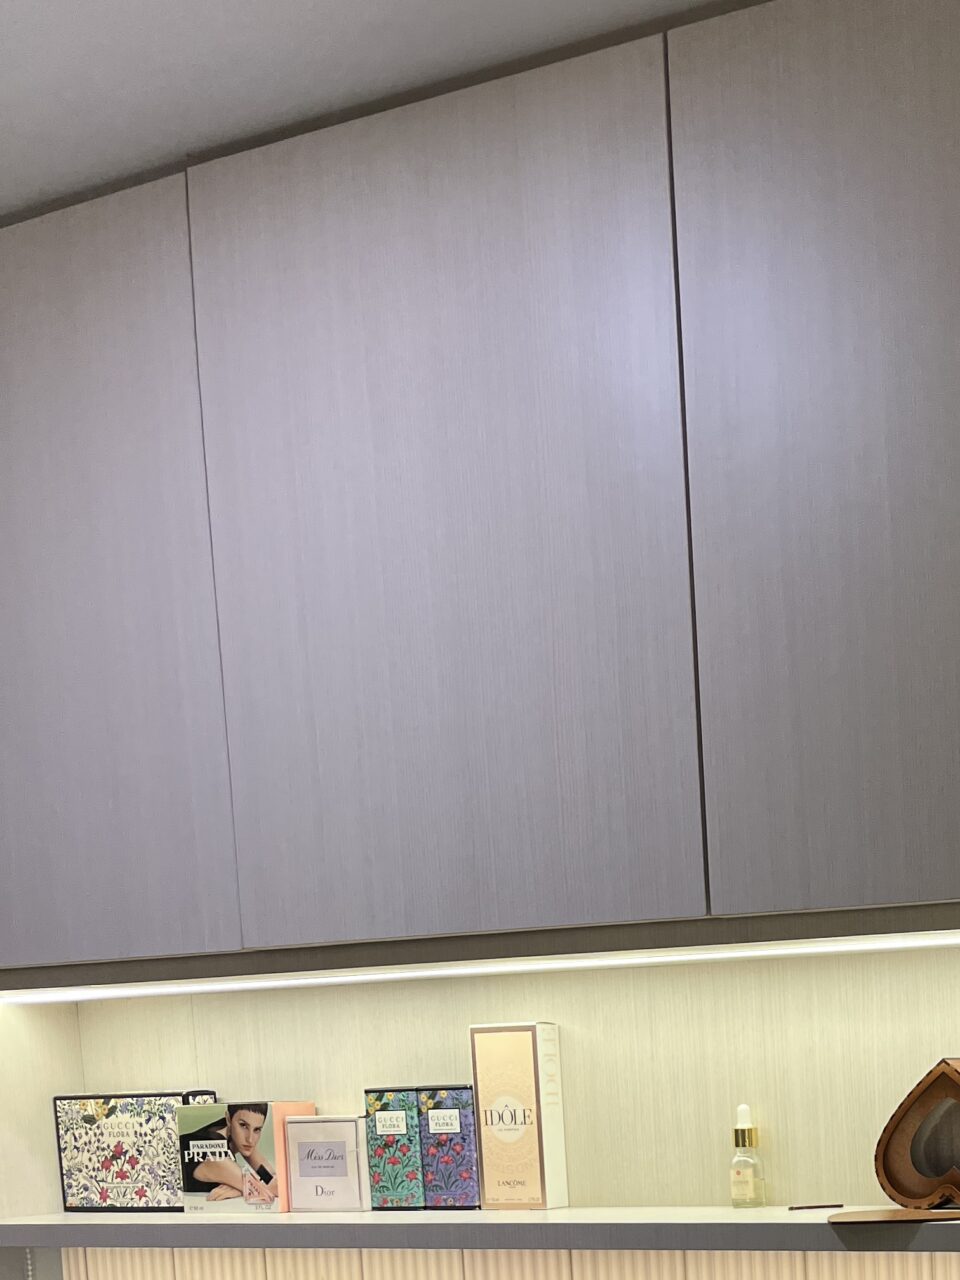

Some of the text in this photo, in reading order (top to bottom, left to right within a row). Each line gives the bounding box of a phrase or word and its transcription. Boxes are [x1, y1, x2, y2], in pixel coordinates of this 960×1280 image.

[377, 1115, 404, 1124] GUCCI
[430, 1114, 458, 1122] GUCCI
[103, 1121, 135, 1130] GUCCI
[108, 1130, 131, 1138] FLORA
[184, 1150, 236, 1162] PRADA
[304, 1148, 324, 1160] Miss
[315, 1184, 336, 1197] Dior
